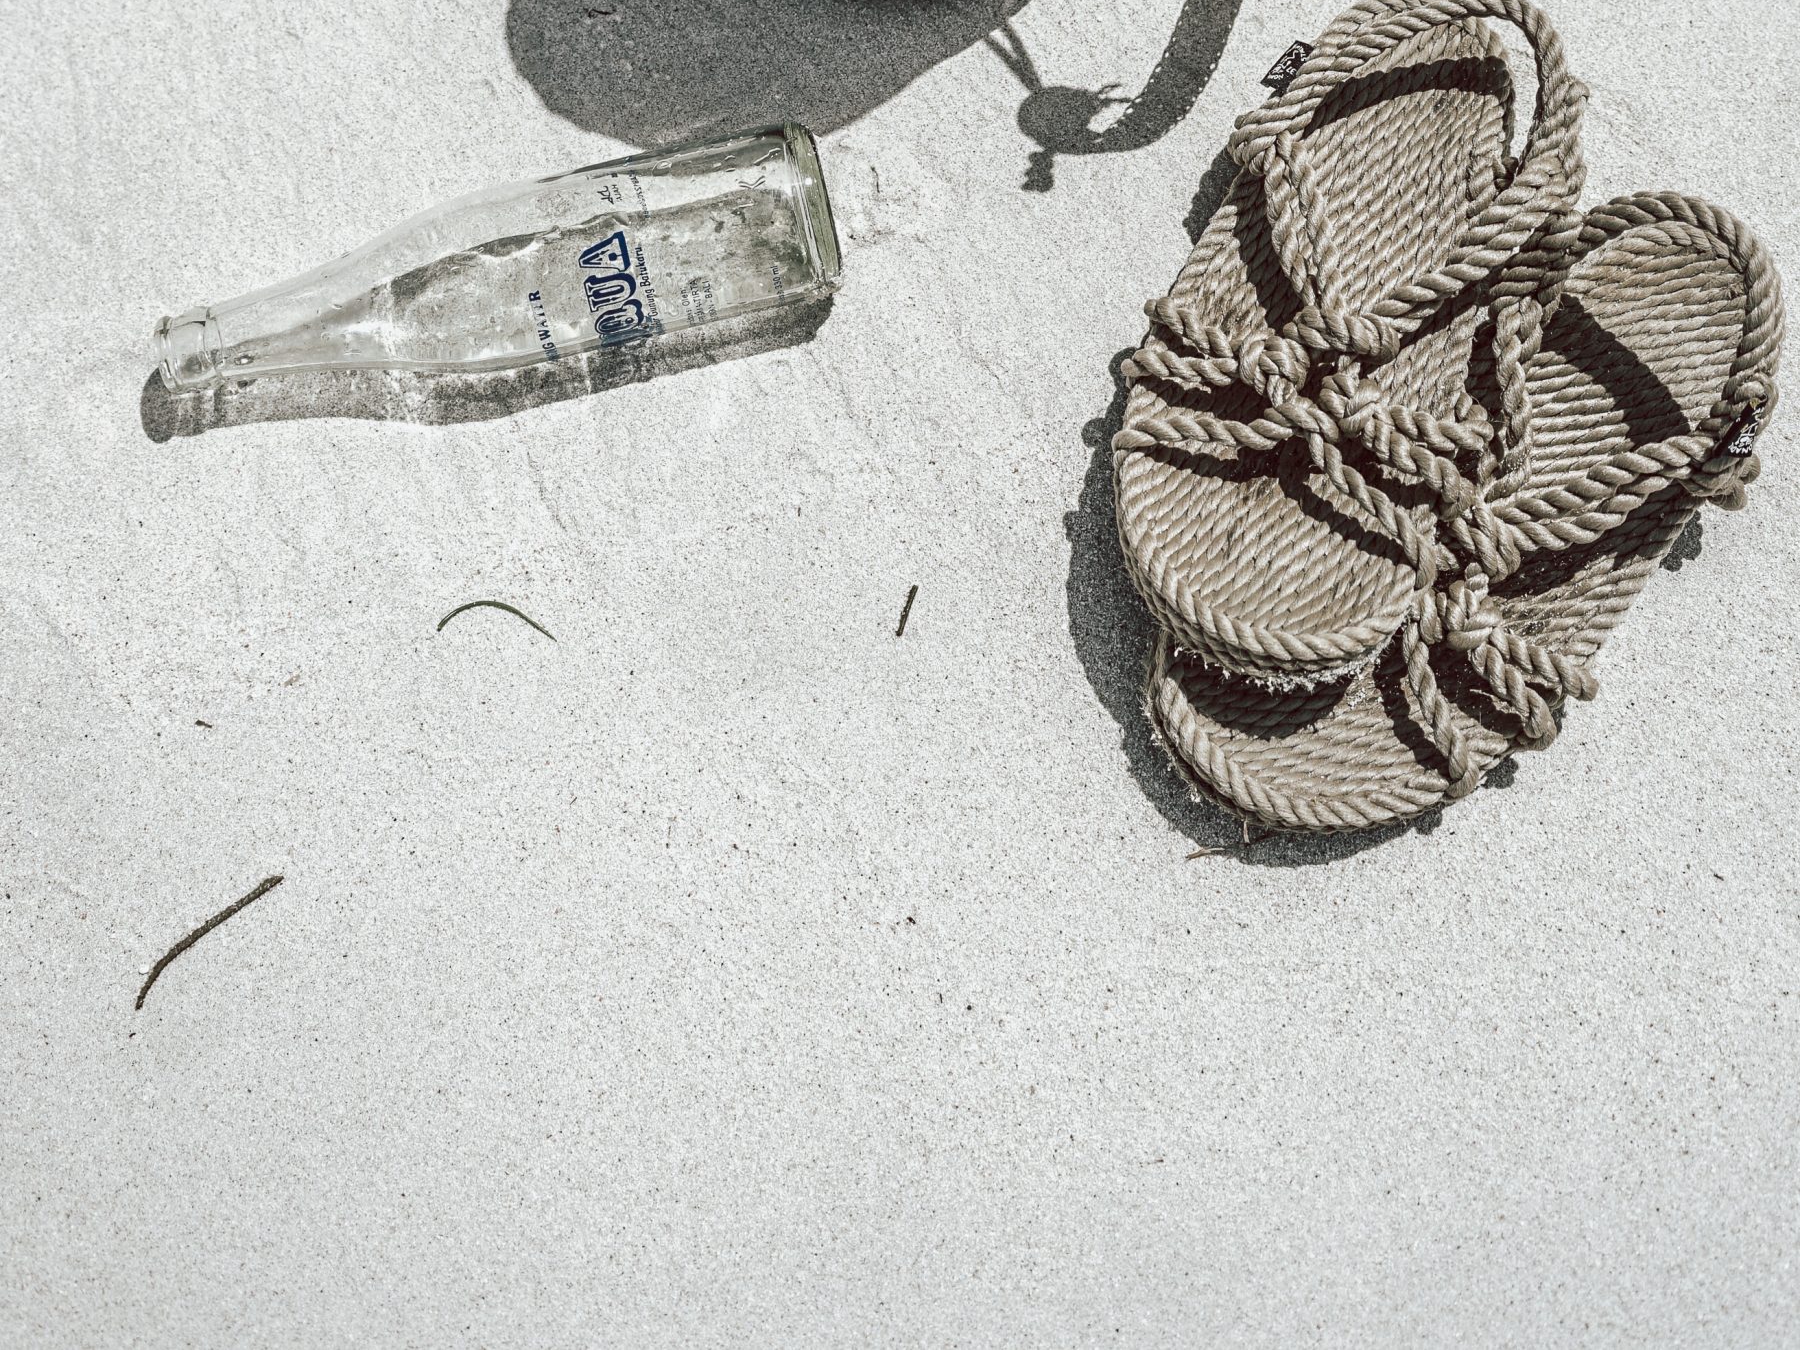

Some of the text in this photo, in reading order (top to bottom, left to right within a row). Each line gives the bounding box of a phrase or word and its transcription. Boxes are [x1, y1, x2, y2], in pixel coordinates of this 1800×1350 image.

[635, 246, 651, 287] Batukaru
[702, 281, 713, 299] BALI
[773, 277, 782, 290] 330
[645, 288, 659, 317] Gunung
